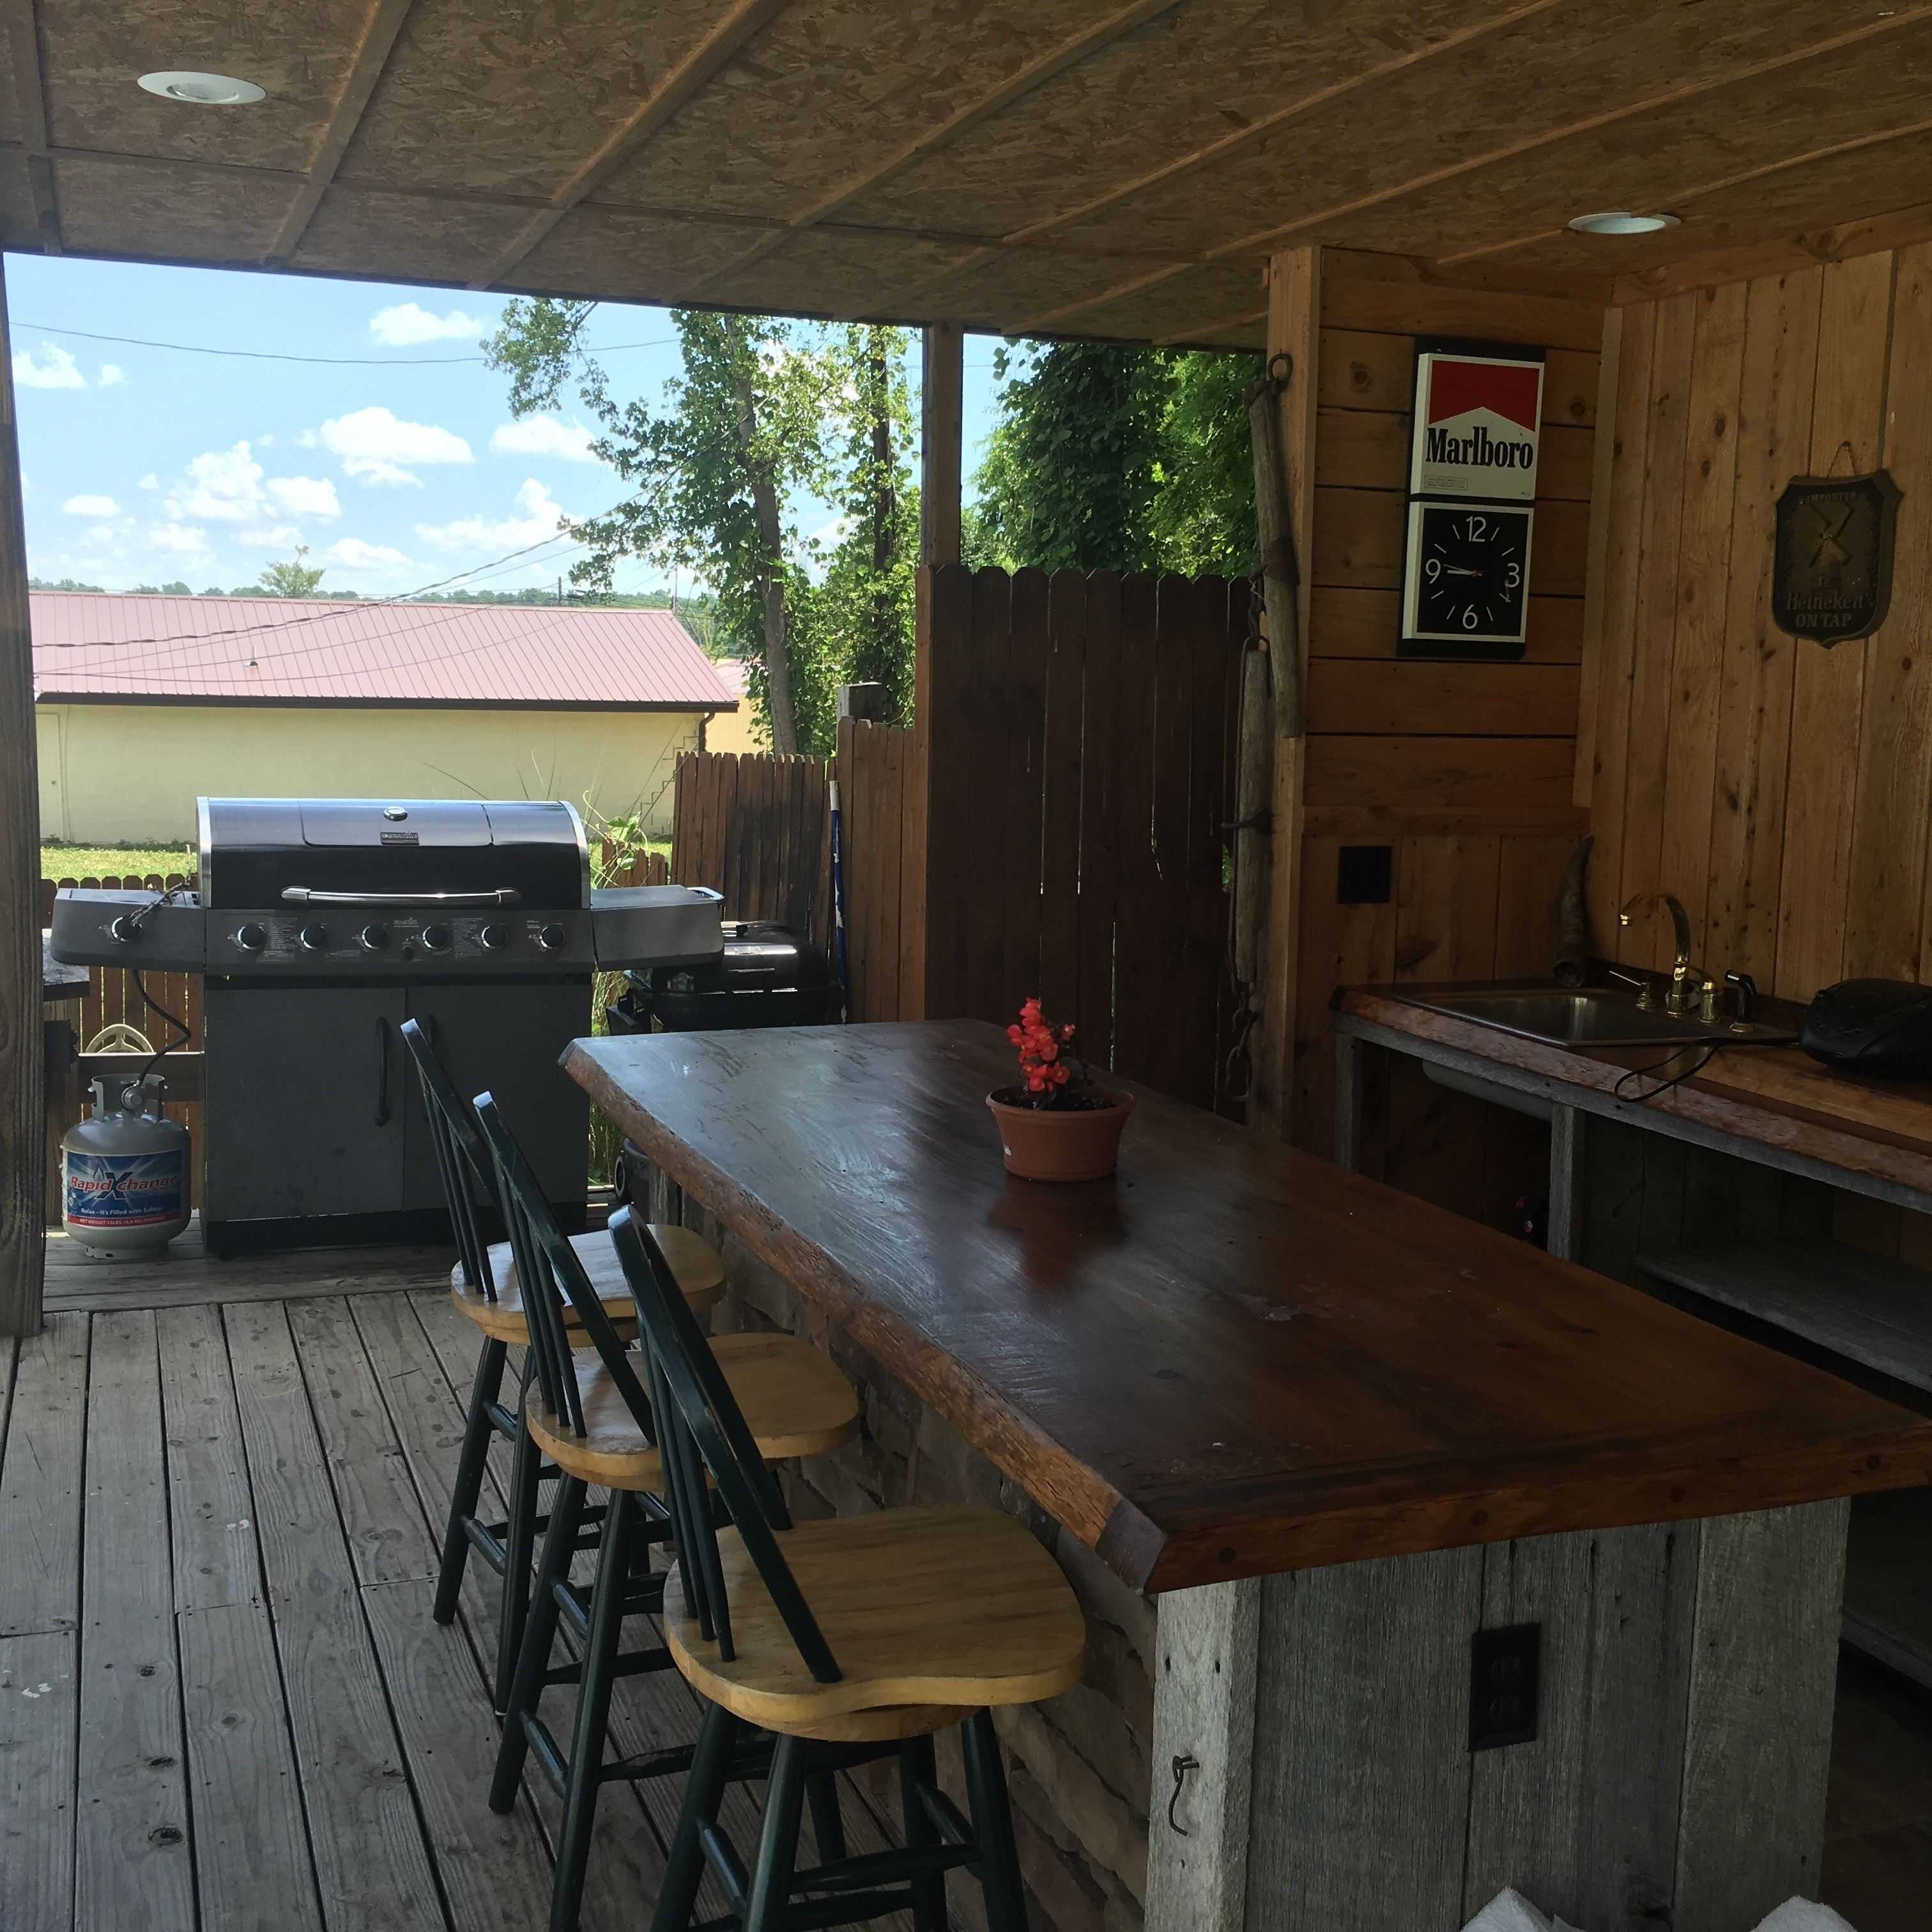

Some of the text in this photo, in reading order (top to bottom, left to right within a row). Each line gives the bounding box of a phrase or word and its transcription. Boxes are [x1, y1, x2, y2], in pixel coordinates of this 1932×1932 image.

[1425, 426, 1533, 470] Marlboro
[1806, 491, 1857, 504] IMPORTED
[1466, 516, 1487, 542] 12
[1425, 558, 1441, 584] 9
[1507, 562, 1520, 588] 3
[1786, 590, 1864, 611] Heineken
[1462, 604, 1478, 629] 6
[1795, 613, 1852, 627] ON TAP
